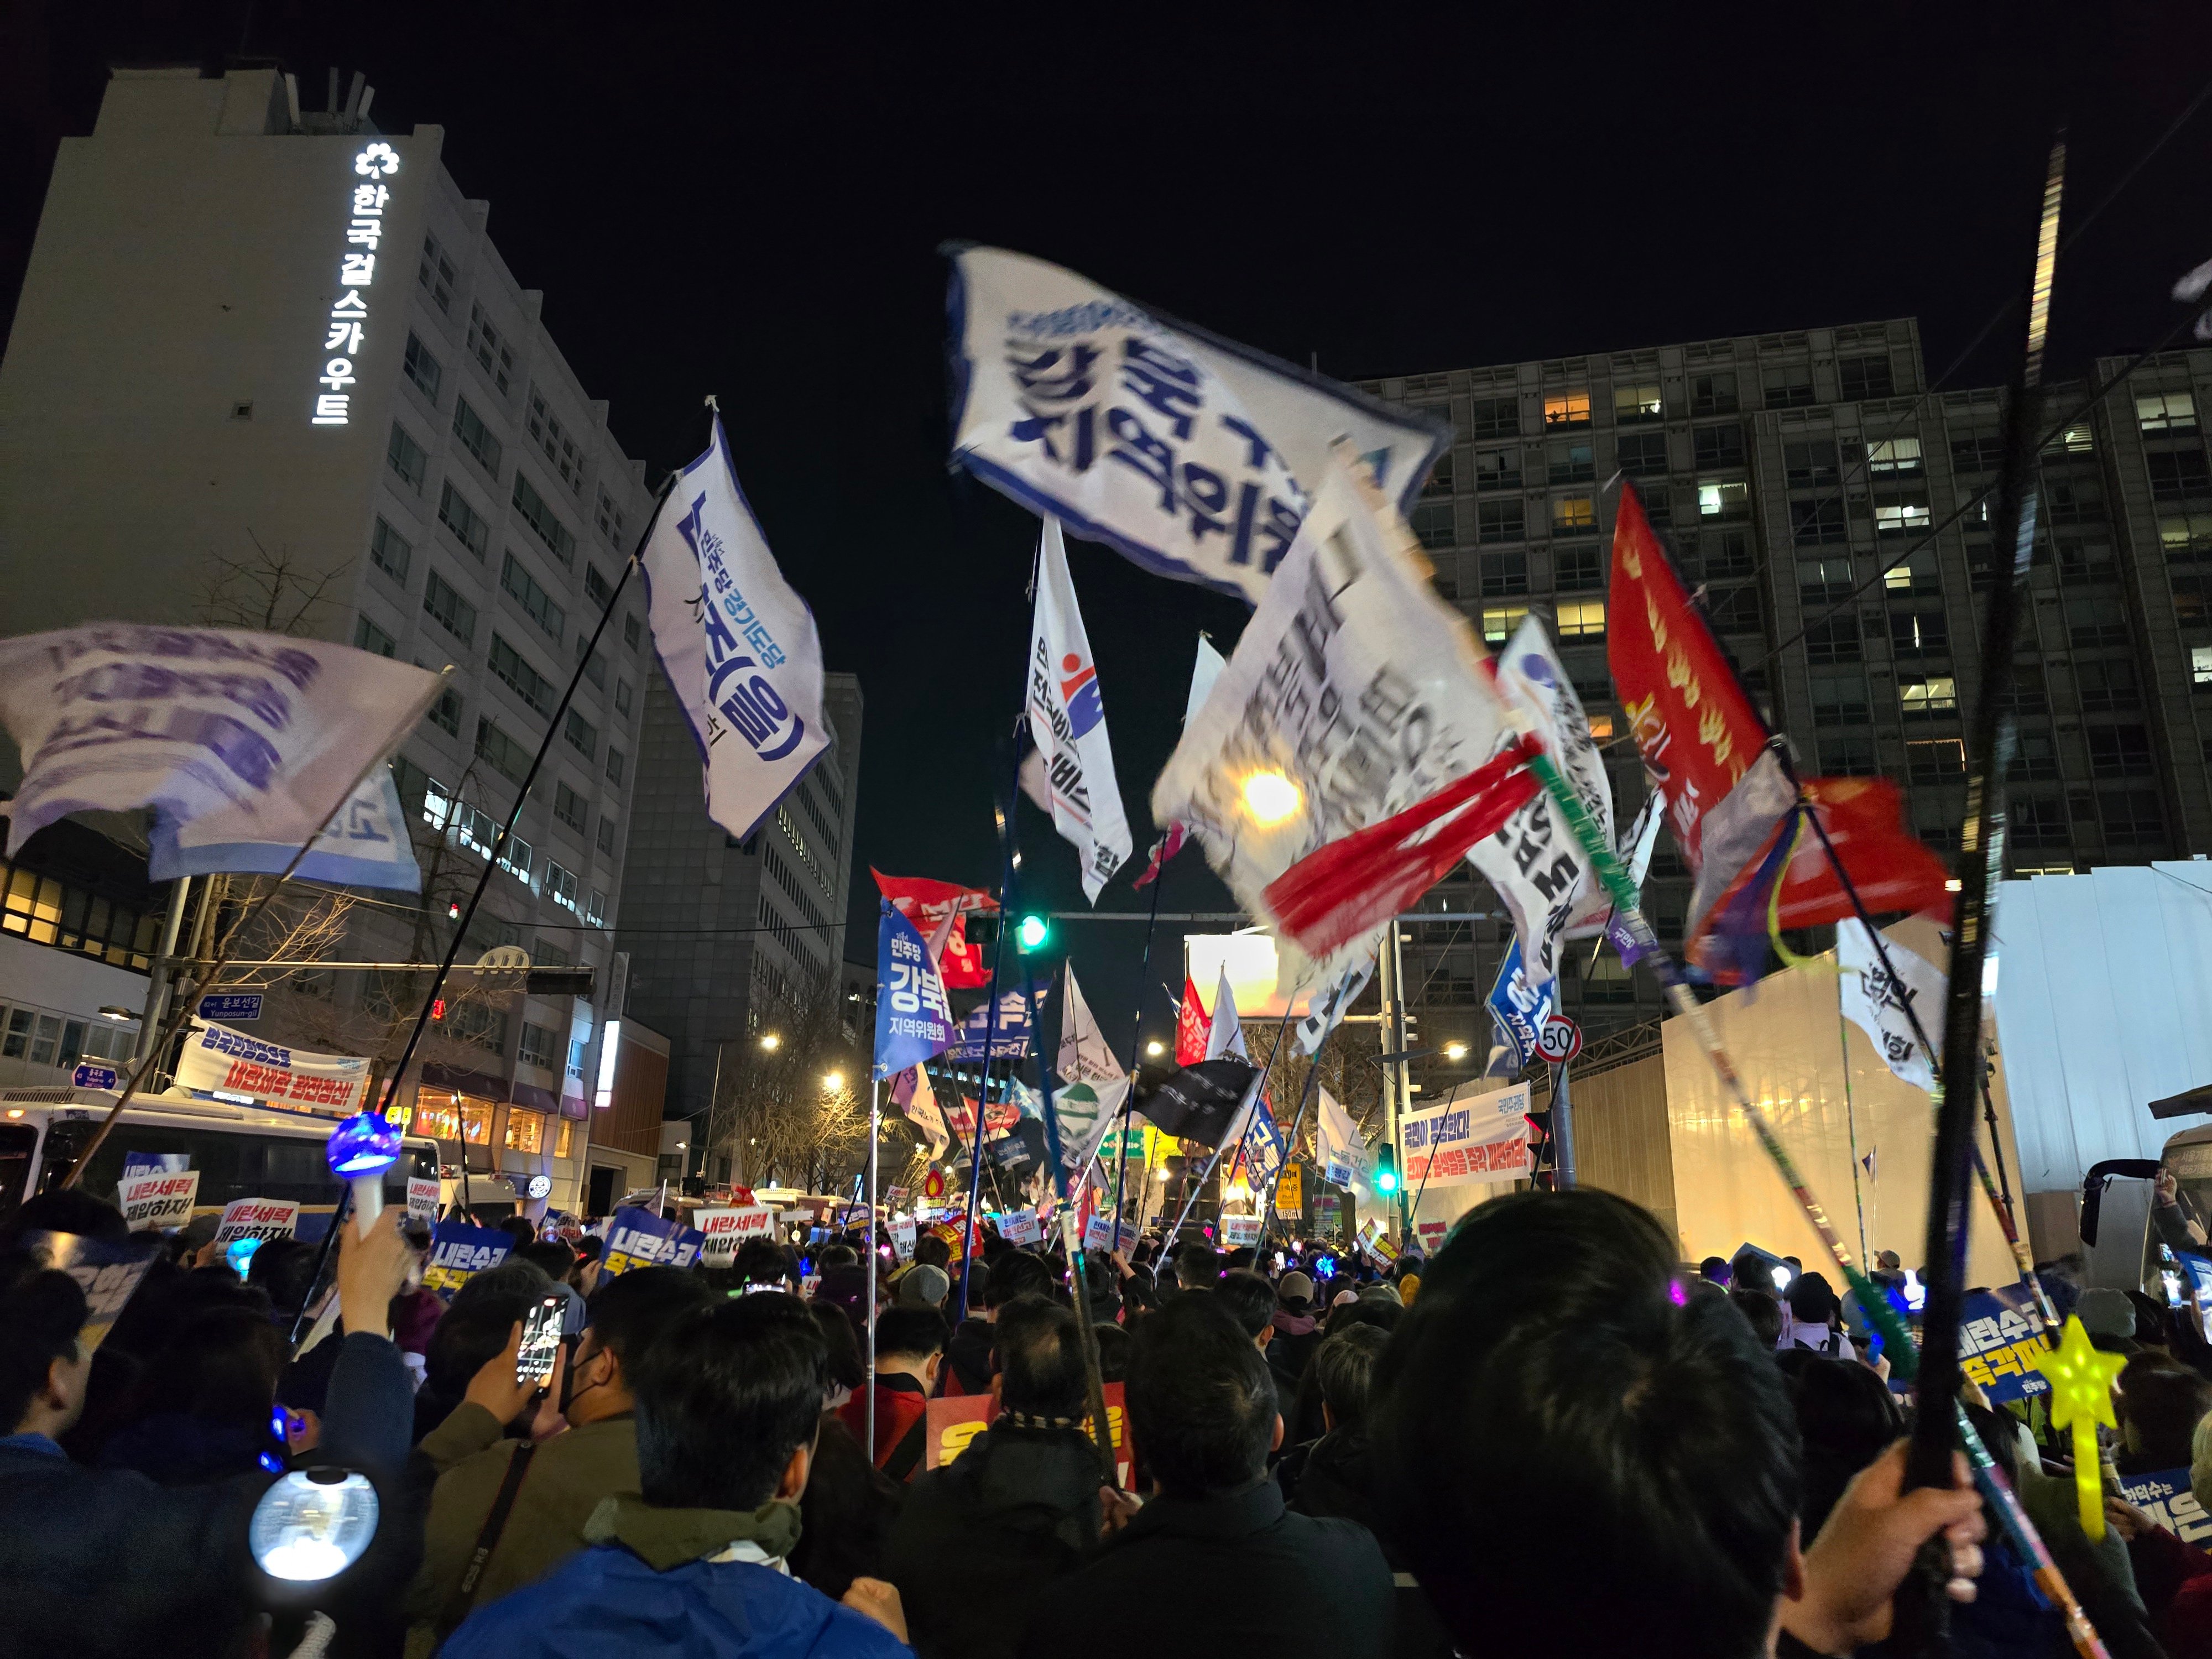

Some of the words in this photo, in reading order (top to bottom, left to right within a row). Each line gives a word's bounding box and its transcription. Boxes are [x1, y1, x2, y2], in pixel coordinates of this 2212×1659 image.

[312, 184, 389, 424] 한국걸스카우트
[701, 529, 734, 594] 민주당
[723, 587, 787, 670] 경기도당
[891, 938, 921, 962] 민주당
[211, 1009, 257, 1018] Yunposun-gil
[222, 997, 260, 1009] 윤보선길
[889, 1018, 945, 1042] 지역위원회
[1543, 1026, 1572, 1051] 50
[201, 1026, 292, 1068] 범국민항쟁으로
[223, 1060, 293, 1097] 내란세력
[1498, 1093, 1524, 1114] 국민주권당
[1405, 1119, 1428, 1149] 국민이
[1430, 1109, 1470, 1145] 명령한다!
[1407, 1155, 1431, 1181] 헌재는
[1433, 1149, 1468, 1178] 윤석열을
[1465, 1145, 1488, 1173] 즉각
[1486, 1138, 1527, 1171] 파면하라!
[126, 1178, 195, 1202] 내란세력
[127, 1197, 194, 1220] 제압하자!
[225, 1204, 294, 1224] 내란세력
[702, 1212, 768, 1234] 내란세력
[2125, 1481, 2174, 1506] 한덕수는
